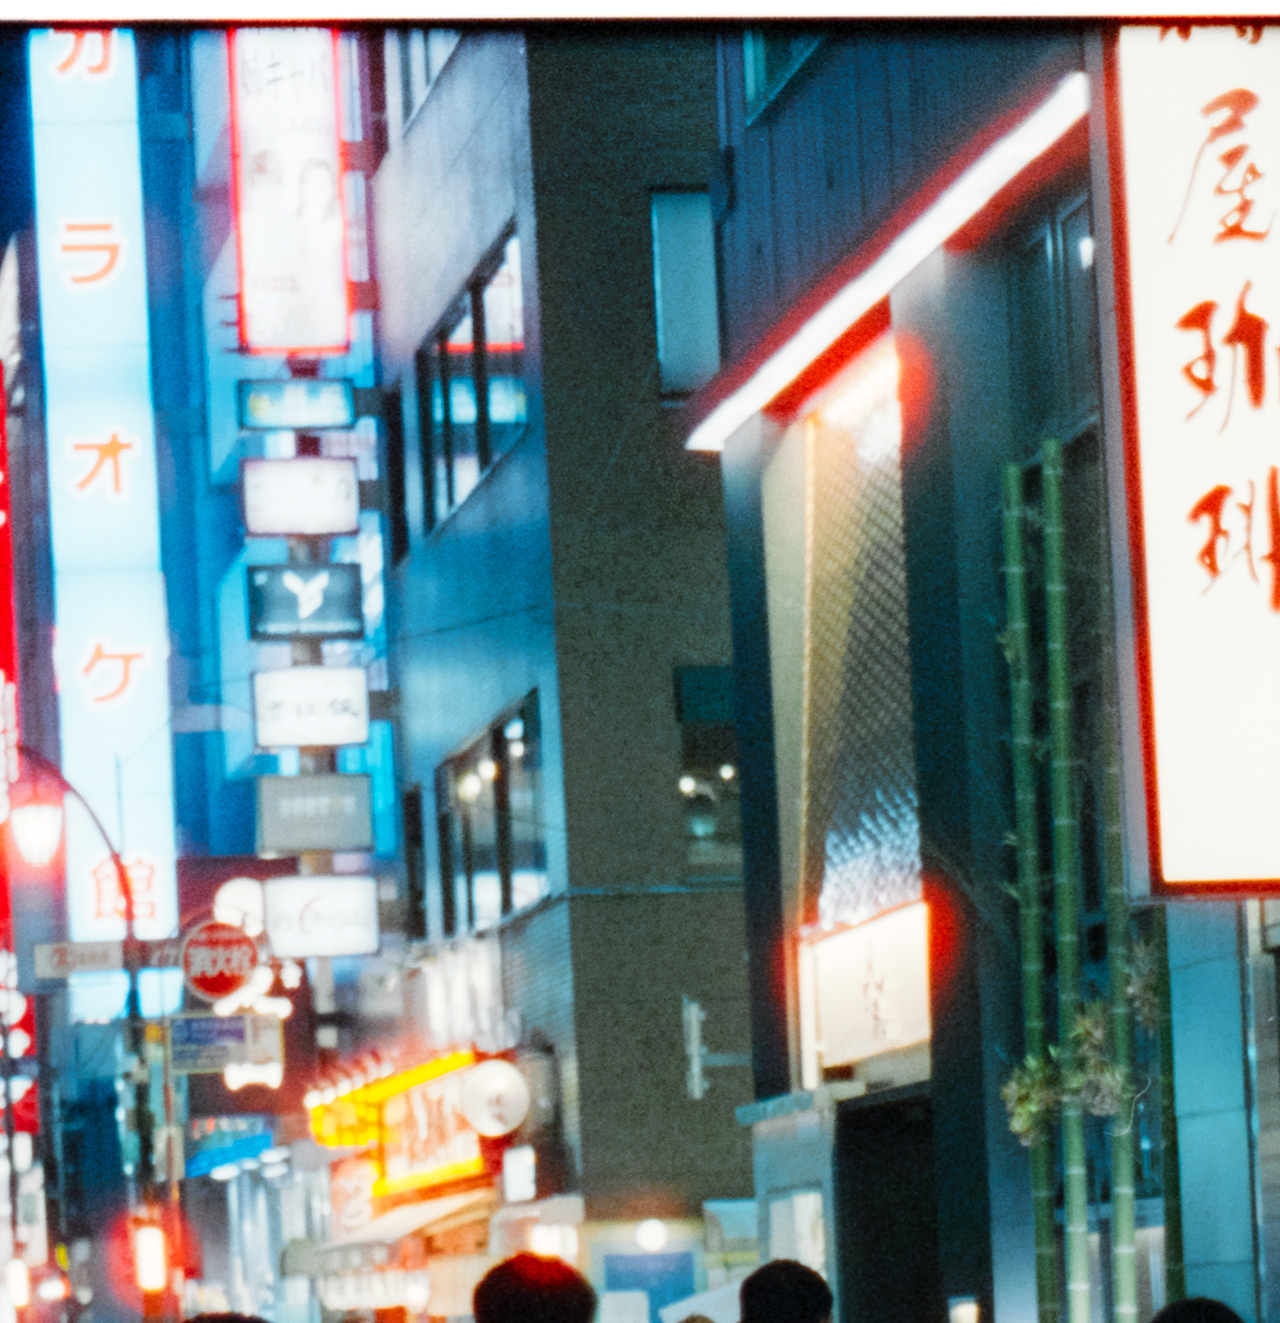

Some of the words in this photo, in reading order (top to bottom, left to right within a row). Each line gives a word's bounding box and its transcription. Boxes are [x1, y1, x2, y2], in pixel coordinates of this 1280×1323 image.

[50, 26, 157, 921] カラオケ館
